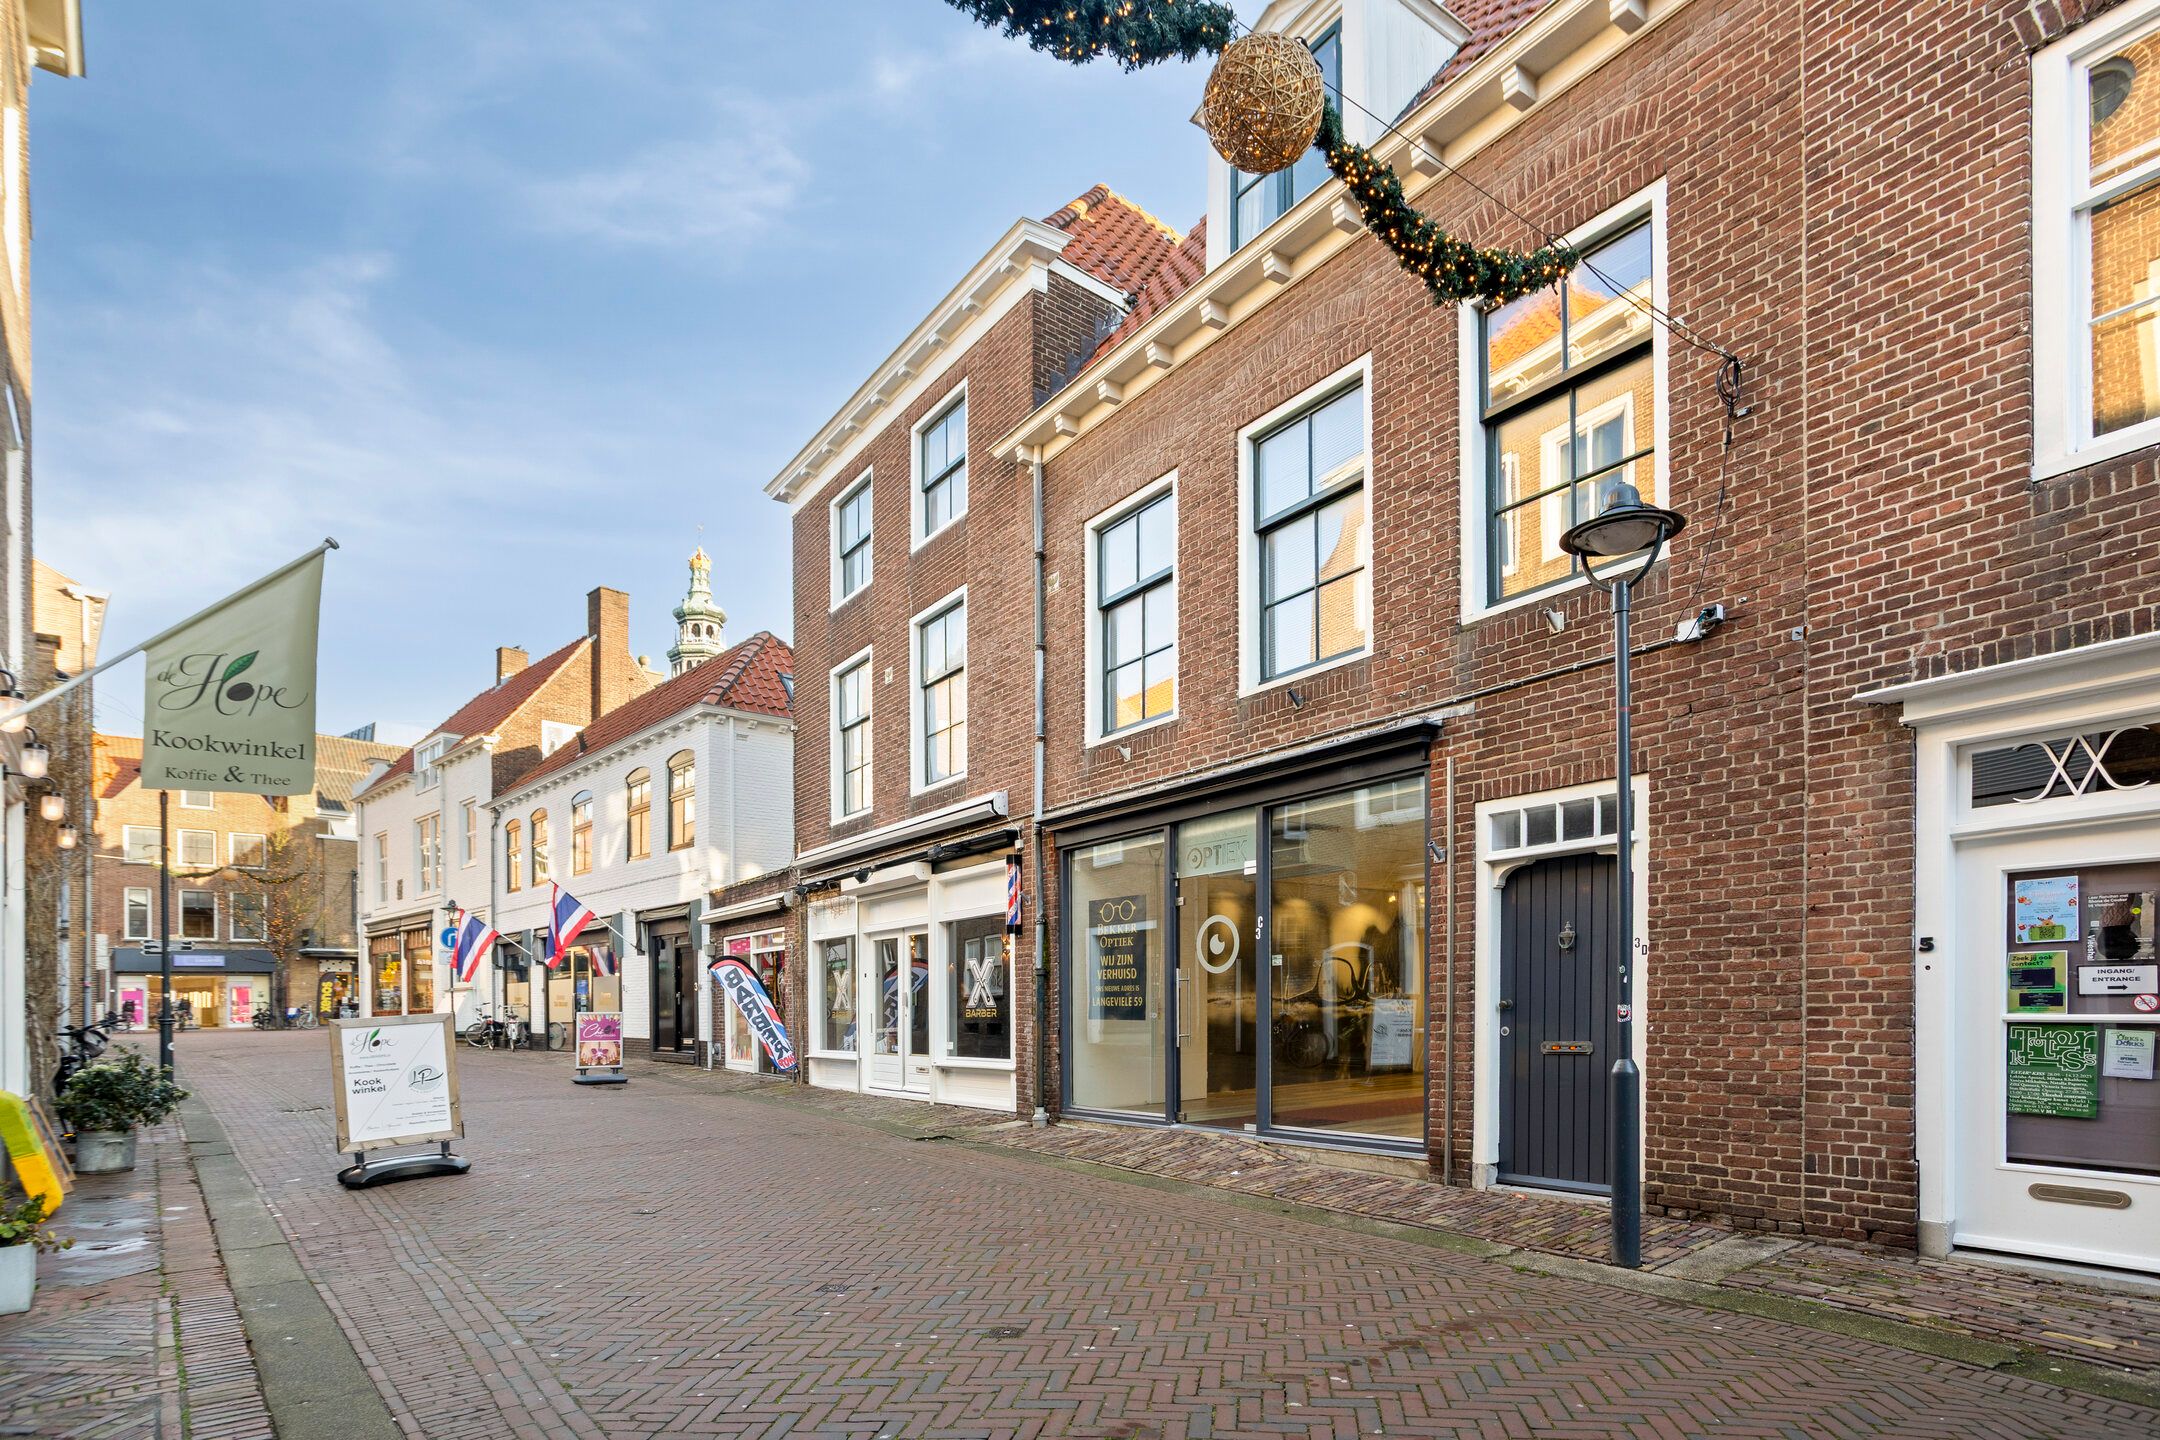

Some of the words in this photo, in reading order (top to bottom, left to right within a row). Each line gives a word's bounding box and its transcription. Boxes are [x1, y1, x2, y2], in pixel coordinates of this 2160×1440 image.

[157, 663, 191, 687] de
[152, 729, 305, 760] Kookwinkel
[165, 766, 217, 782] Koffie
[224, 765, 245, 783] &
[251, 773, 291, 786] Thee
[1258, 916, 1264, 928] C
[1097, 923, 1137, 936] BEKKER
[1255, 928, 1261, 940] 3
[1100, 936, 1134, 948] OPTIEK
[1634, 938, 1641, 948] 3
[1642, 944, 1647, 955] D
[1919, 937, 1934, 952] 5
[1100, 956, 1115, 966] WIJ
[1117, 954, 1134, 965] ZIJN
[1097, 968, 1137, 980] VERHUISD
[320, 982, 332, 1012] xenos
[1092, 997, 1132, 1007] LANGEVIELE
[1134, 996, 1142, 1007] 59
[965, 1008, 997, 1018] BARBER
[354, 1078, 382, 1087] Kook
[352, 1085, 386, 1094] winkel
